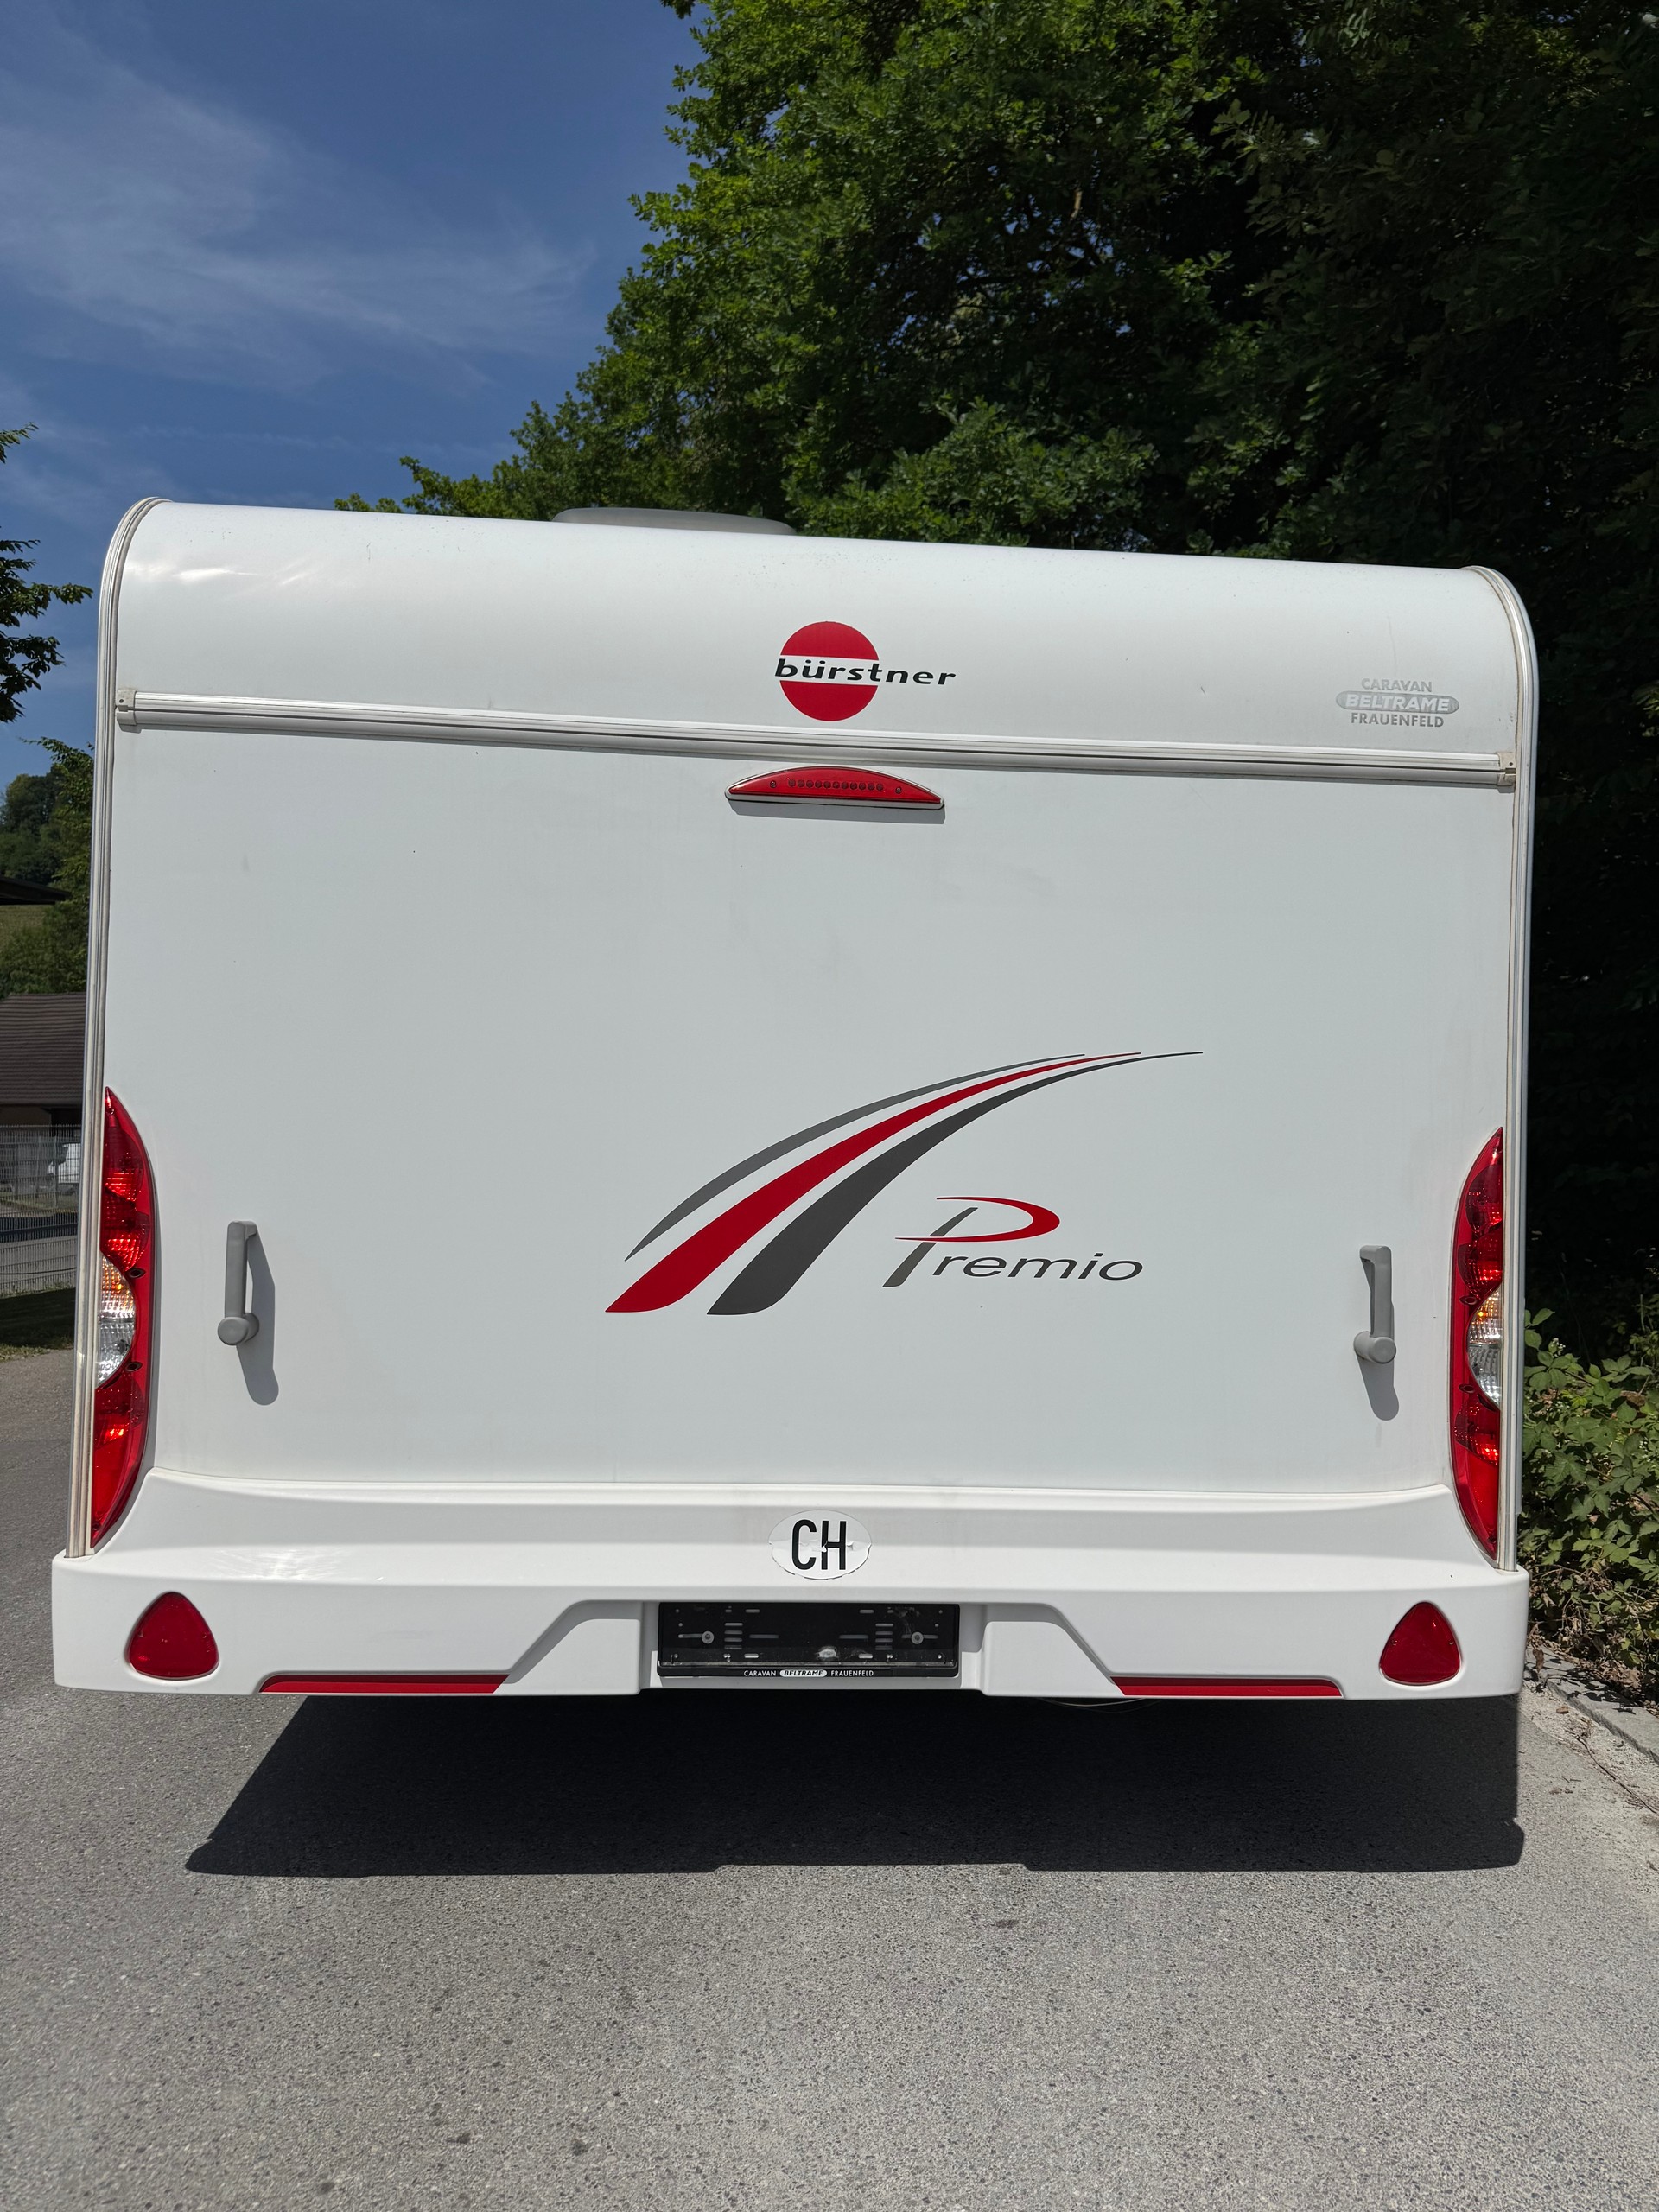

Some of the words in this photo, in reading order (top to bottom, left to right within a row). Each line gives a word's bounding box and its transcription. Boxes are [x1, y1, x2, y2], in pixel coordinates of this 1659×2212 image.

[774, 658, 957, 685] bürstner
[1361, 677, 1433, 693] CARAVAN
[1344, 693, 1450, 712] BELTRAME
[1351, 712, 1445, 728] FRAUENFELD
[882, 1196, 1143, 1287] Premio
[791, 1518, 848, 1571] CH
